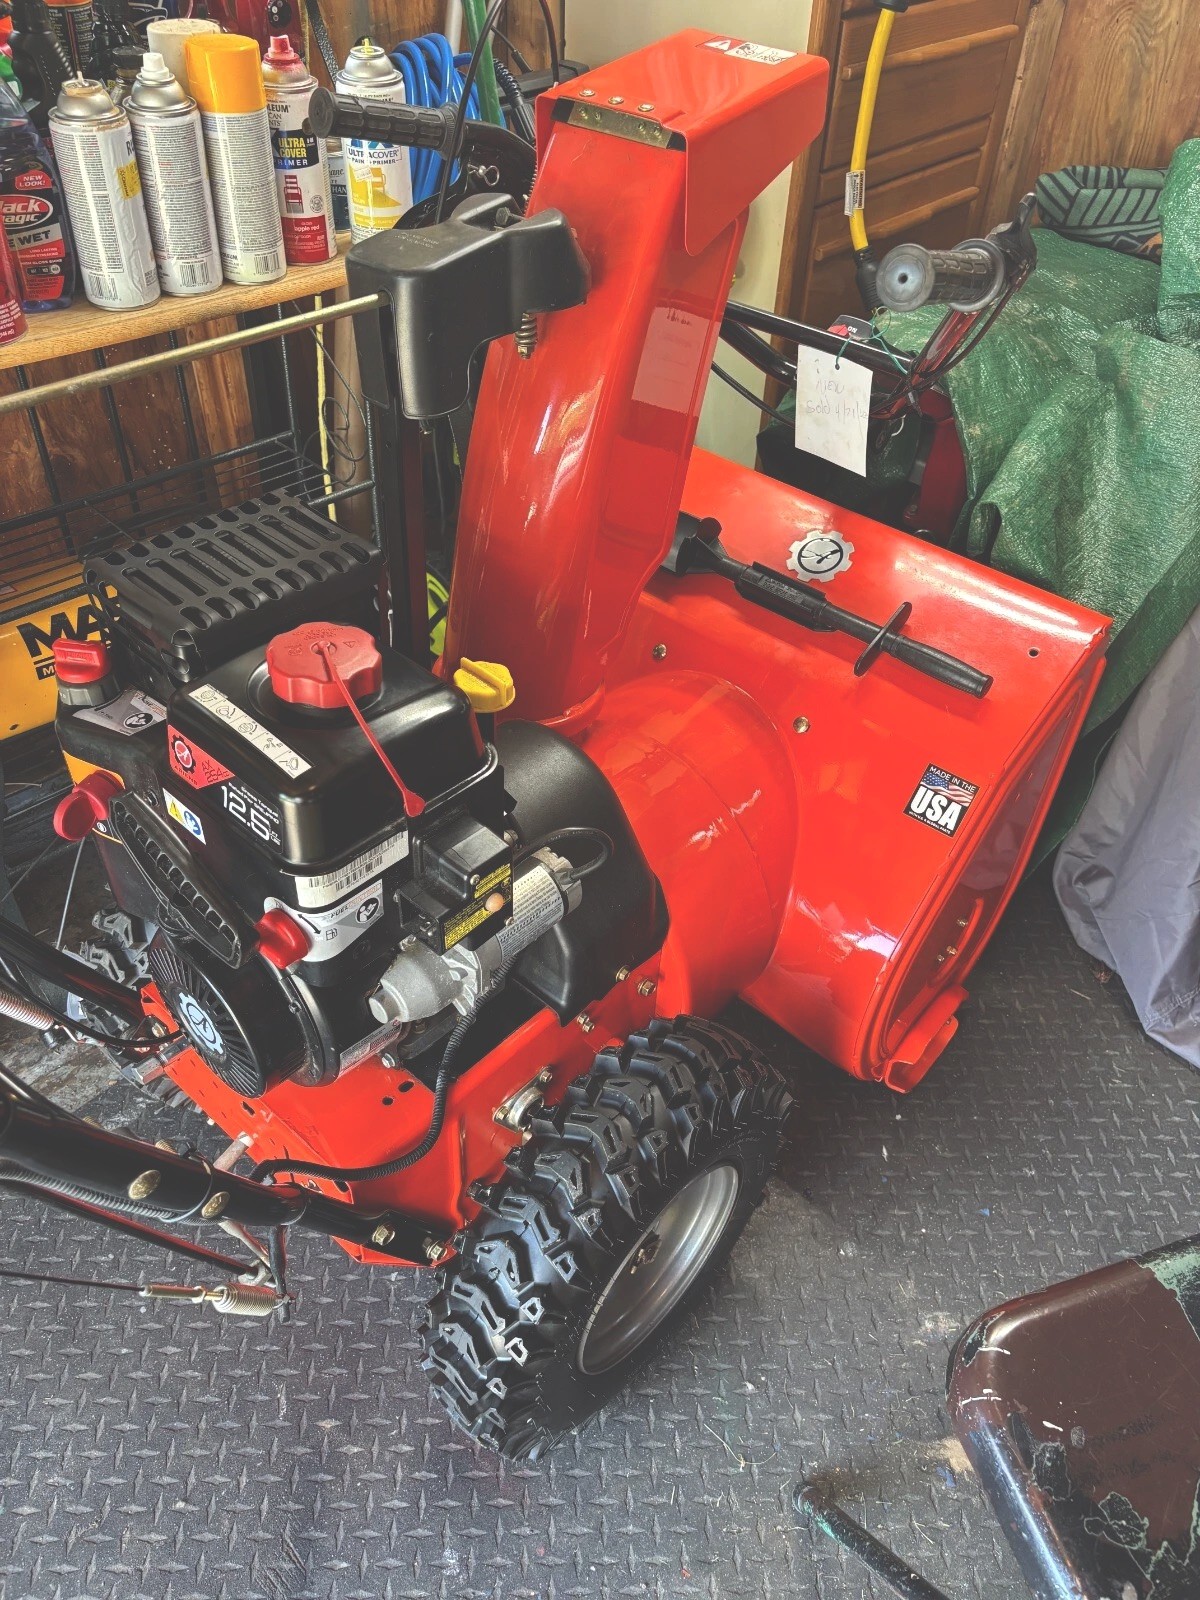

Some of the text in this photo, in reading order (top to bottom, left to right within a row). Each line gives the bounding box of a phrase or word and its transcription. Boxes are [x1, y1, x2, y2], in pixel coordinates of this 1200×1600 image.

[267, 104, 290, 113] LEUM
[278, 137, 306, 148] ULTRA
[280, 147, 307, 158] COVER
[3, 213, 40, 224] agic
[17, 229, 51, 246] WET
[929, 766, 977, 793] MADE IN THE
[220, 785, 270, 841] 12.5
[910, 785, 962, 831] USA
